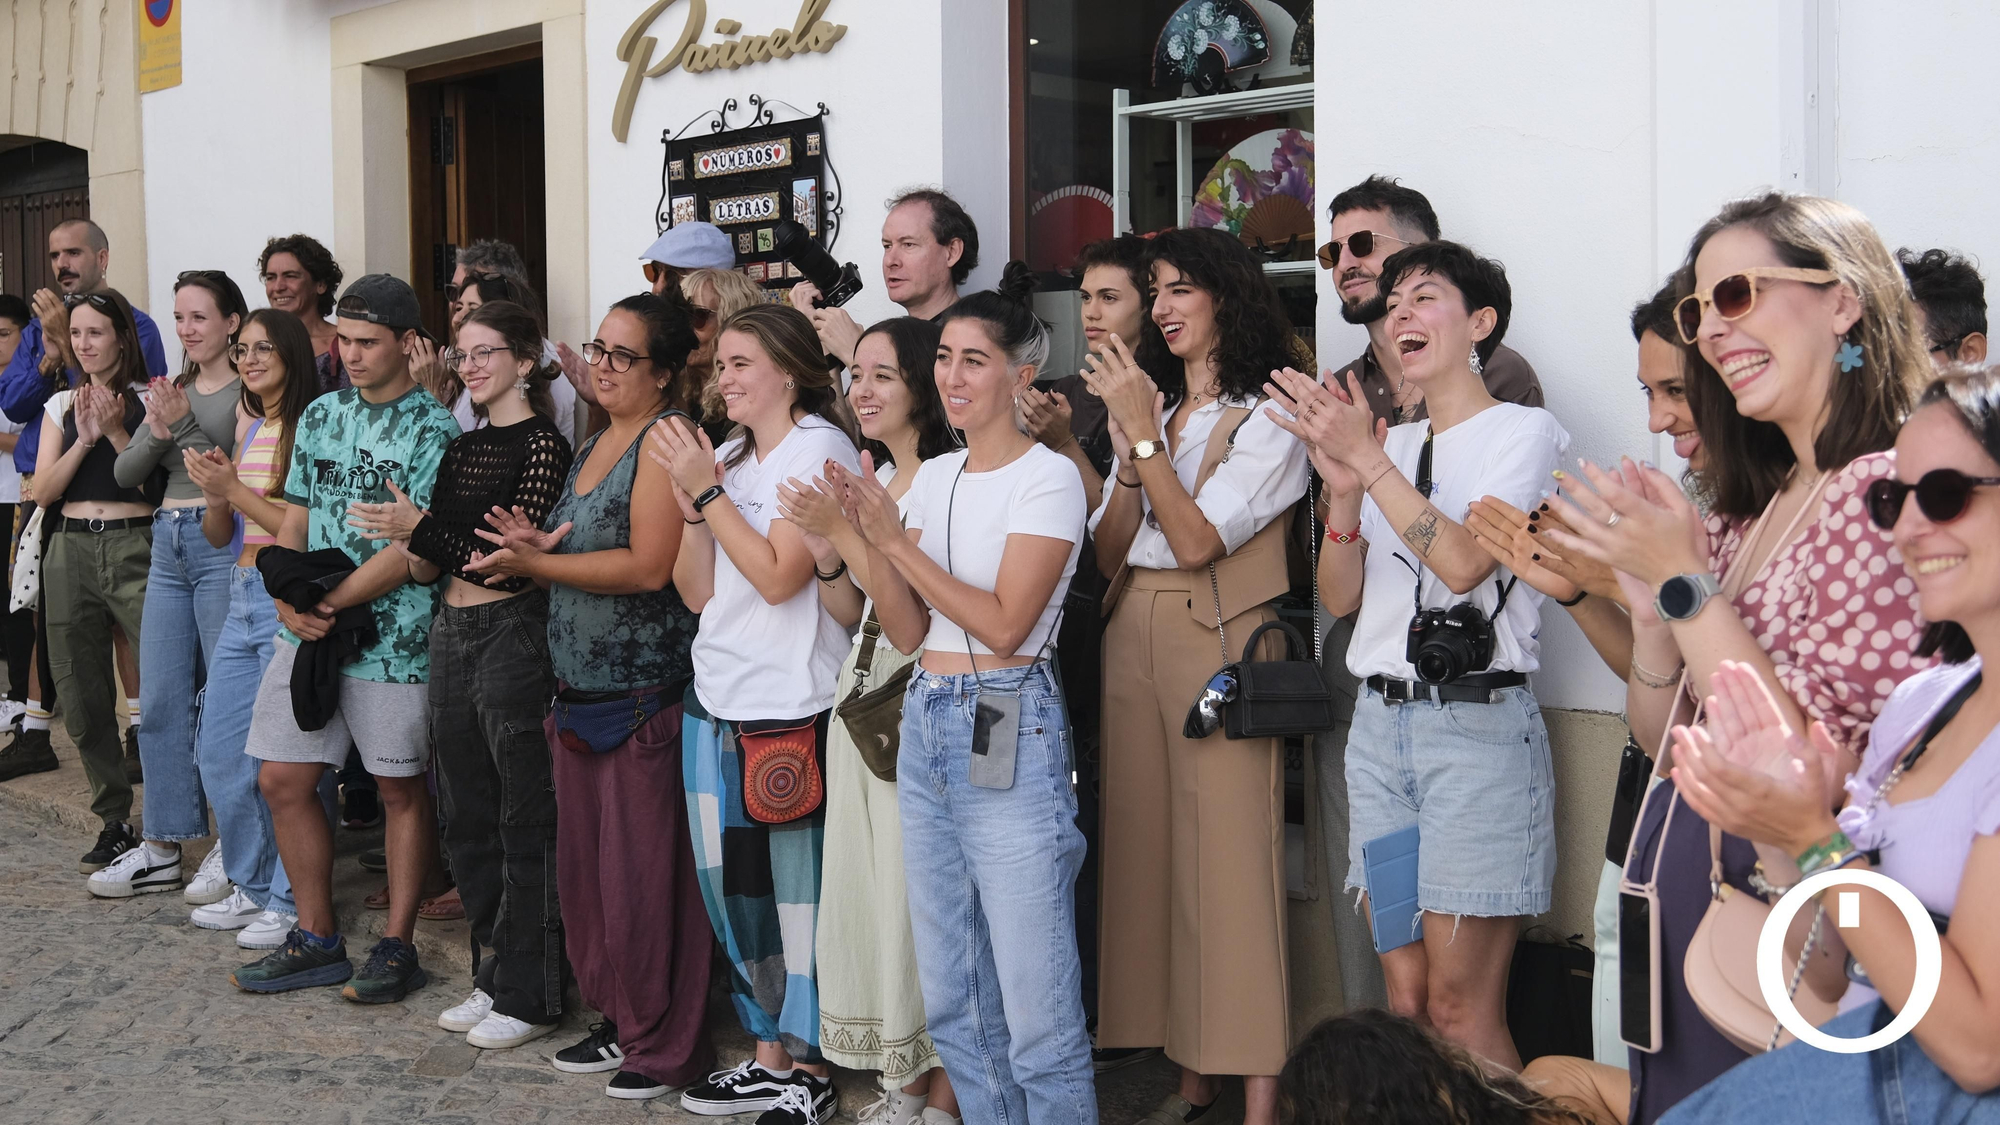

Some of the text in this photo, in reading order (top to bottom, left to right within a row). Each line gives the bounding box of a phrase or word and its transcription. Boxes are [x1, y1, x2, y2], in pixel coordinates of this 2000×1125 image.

[612, 0, 848, 142] Pañuelo
[711, 148, 772, 169] NUMEROS
[718, 199, 770, 219] LETRAS
